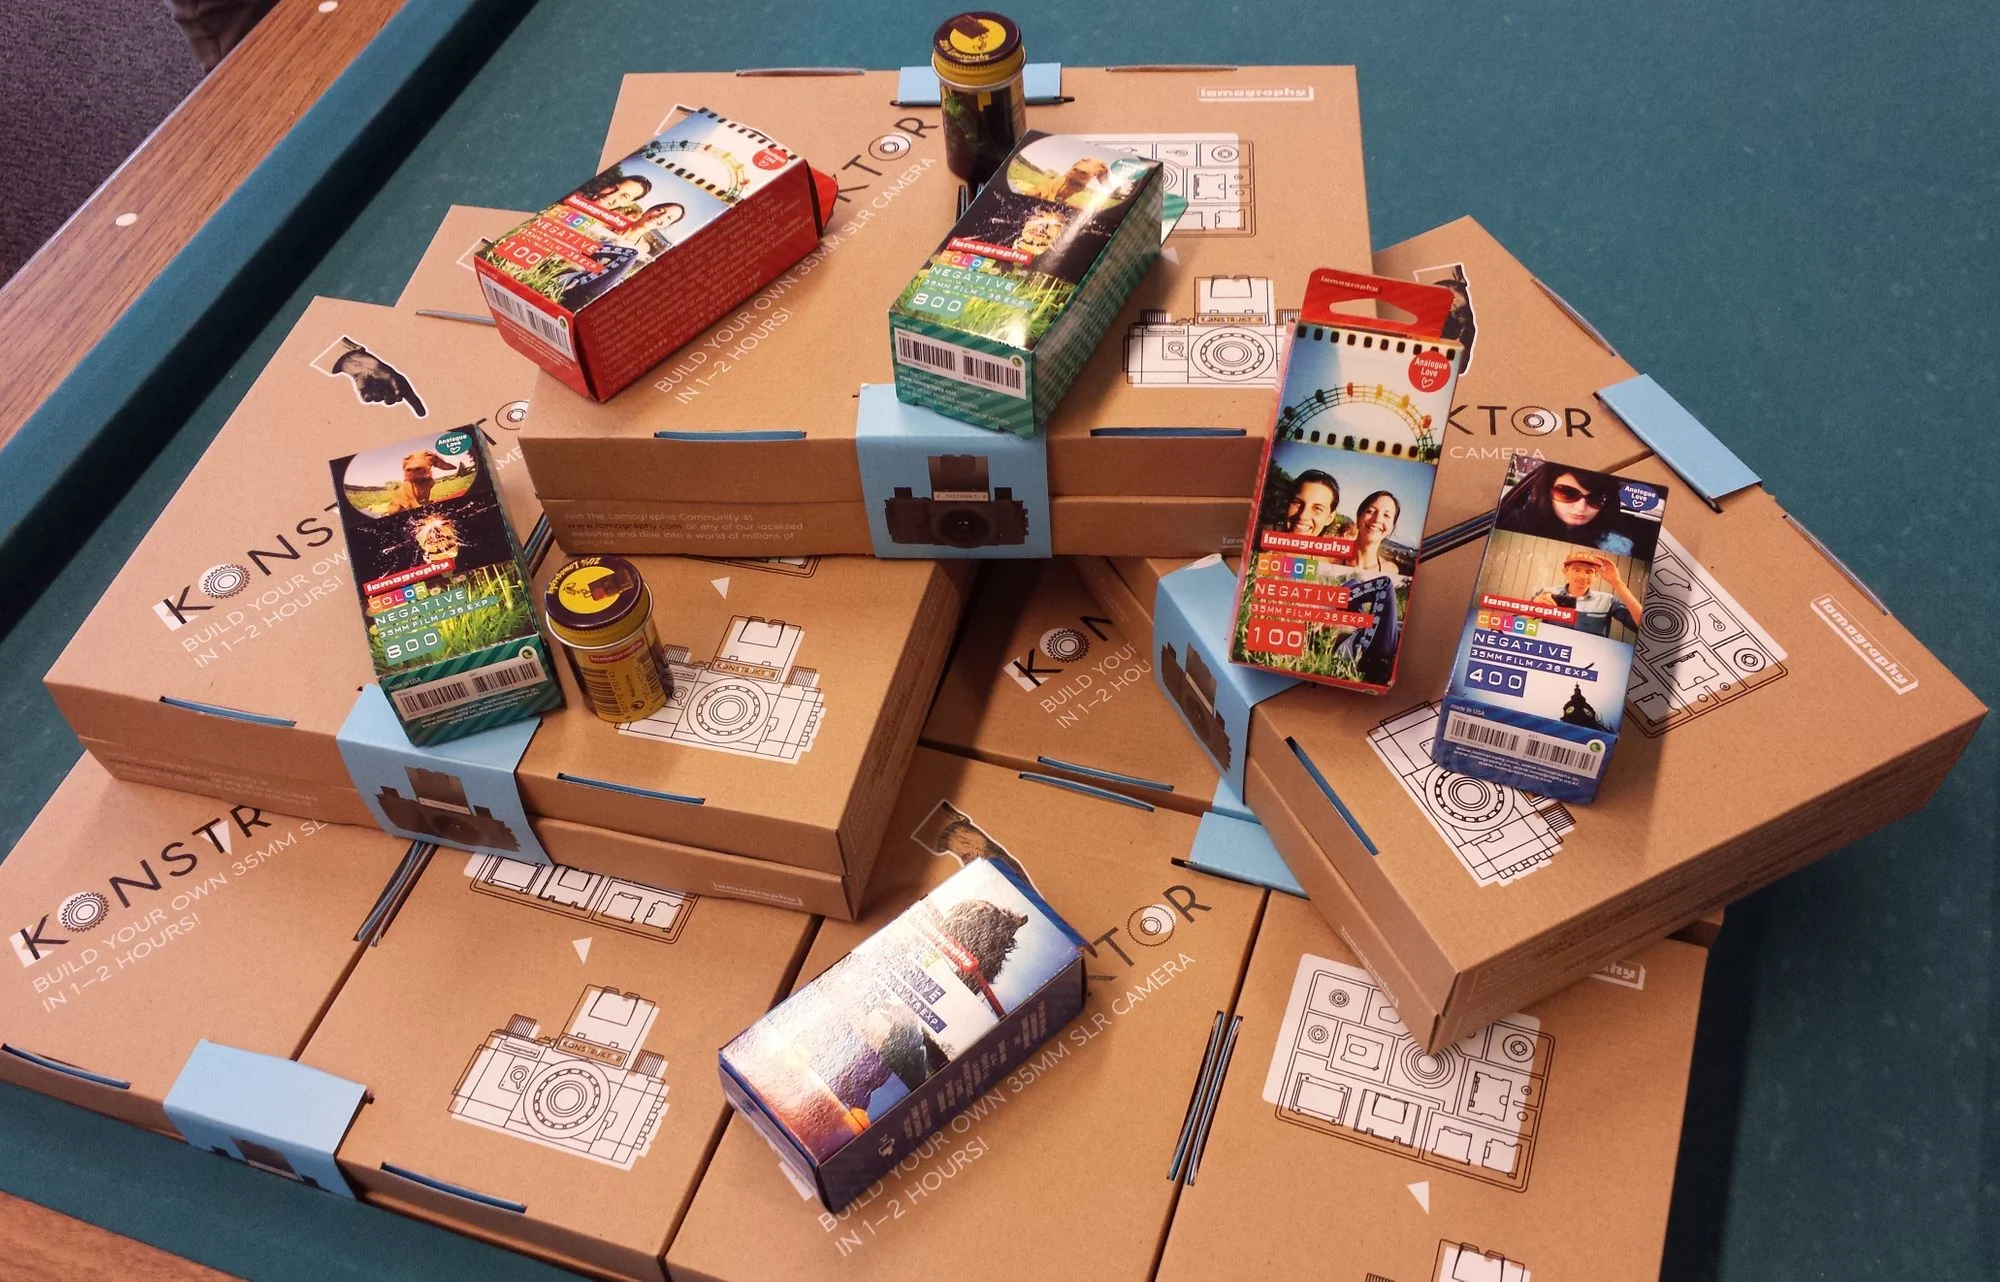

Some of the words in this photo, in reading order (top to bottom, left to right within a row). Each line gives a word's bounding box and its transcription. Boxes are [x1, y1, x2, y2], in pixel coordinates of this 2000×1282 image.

[1199, 87, 1308, 99] lomography
[569, 195, 627, 228] lomography
[535, 219, 598, 253] NEGATIVE
[503, 241, 543, 265] 100
[940, 251, 994, 271] COLOR
[951, 239, 1029, 262] lomography
[654, 351, 707, 394] BUILD
[704, 311, 758, 351] YOUR
[754, 275, 799, 310] OWN
[795, 234, 845, 276] 35MM
[841, 209, 877, 236] SLR
[872, 155, 937, 209] CAMERA
[930, 264, 1016, 292] NEGATIVE
[913, 292, 962, 313] 800
[674, 385, 701, 405] IN
[729, 306, 793, 362] HOURS!
[1414, 357, 1448, 370] Analogue
[1420, 367, 1439, 378] Love
[438, 434, 468, 446] Analogue
[446, 441, 462, 449] Love
[1624, 485, 1656, 498] Analogue
[1631, 492, 1648, 502] Love
[679, 513, 740, 522] Community
[700, 524, 718, 532] any
[695, 532, 726, 540] world
[1263, 533, 1351, 554] lomography
[366, 559, 451, 593] lomography
[1258, 558, 1316, 576] COLOR
[370, 585, 428, 610] COLOR
[1254, 582, 1348, 605] NEGATIVE
[181, 611, 244, 653] BUILD
[247, 574, 309, 612] YOUR
[374, 589, 466, 627] NEGATIVE
[1252, 603, 1283, 615] 35MM
[1286, 609, 1313, 619] FILM
[1323, 612, 1339, 622] 36
[1483, 595, 1572, 619] lomography
[193, 648, 219, 669] IN
[262, 575, 344, 628] HOURS!
[378, 623, 411, 639] 35MM
[412, 614, 440, 628] FILM
[1477, 615, 1539, 633] COLOR
[386, 632, 438, 660] 800
[1253, 627, 1303, 648] 100
[1473, 632, 1572, 659] NEGATIVE
[1818, 597, 1909, 685] lomography
[1471, 649, 1504, 662] 35MM
[1505, 654, 1535, 668] FILM
[1545, 663, 1562, 674] 36
[1468, 667, 1524, 690] 400
[1039, 674, 1093, 714] BUILD
[1055, 710, 1080, 729] IN
[1472, 708, 1486, 717] USA
[32, 948, 98, 994] BUILD
[101, 908, 168, 951] YOUR
[171, 871, 229, 911] OWN
[231, 831, 297, 877] 35MM
[41, 990, 68, 1014] IN
[115, 911, 202, 970] HOURS!
[560, 1040, 622, 1063] KONSTRUKTOR
[817, 1179, 885, 1233] BUILD
[889, 1131, 950, 1180] YOUR
[951, 1089, 1007, 1134] OWN
[1006, 1040, 1071, 1093] 35MM
[1069, 1012, 1113, 1048] SLR
[1111, 952, 1196, 1016] CAMERA
[834, 1229, 864, 1257] IN
[904, 1135, 990, 1205] HOURS!
